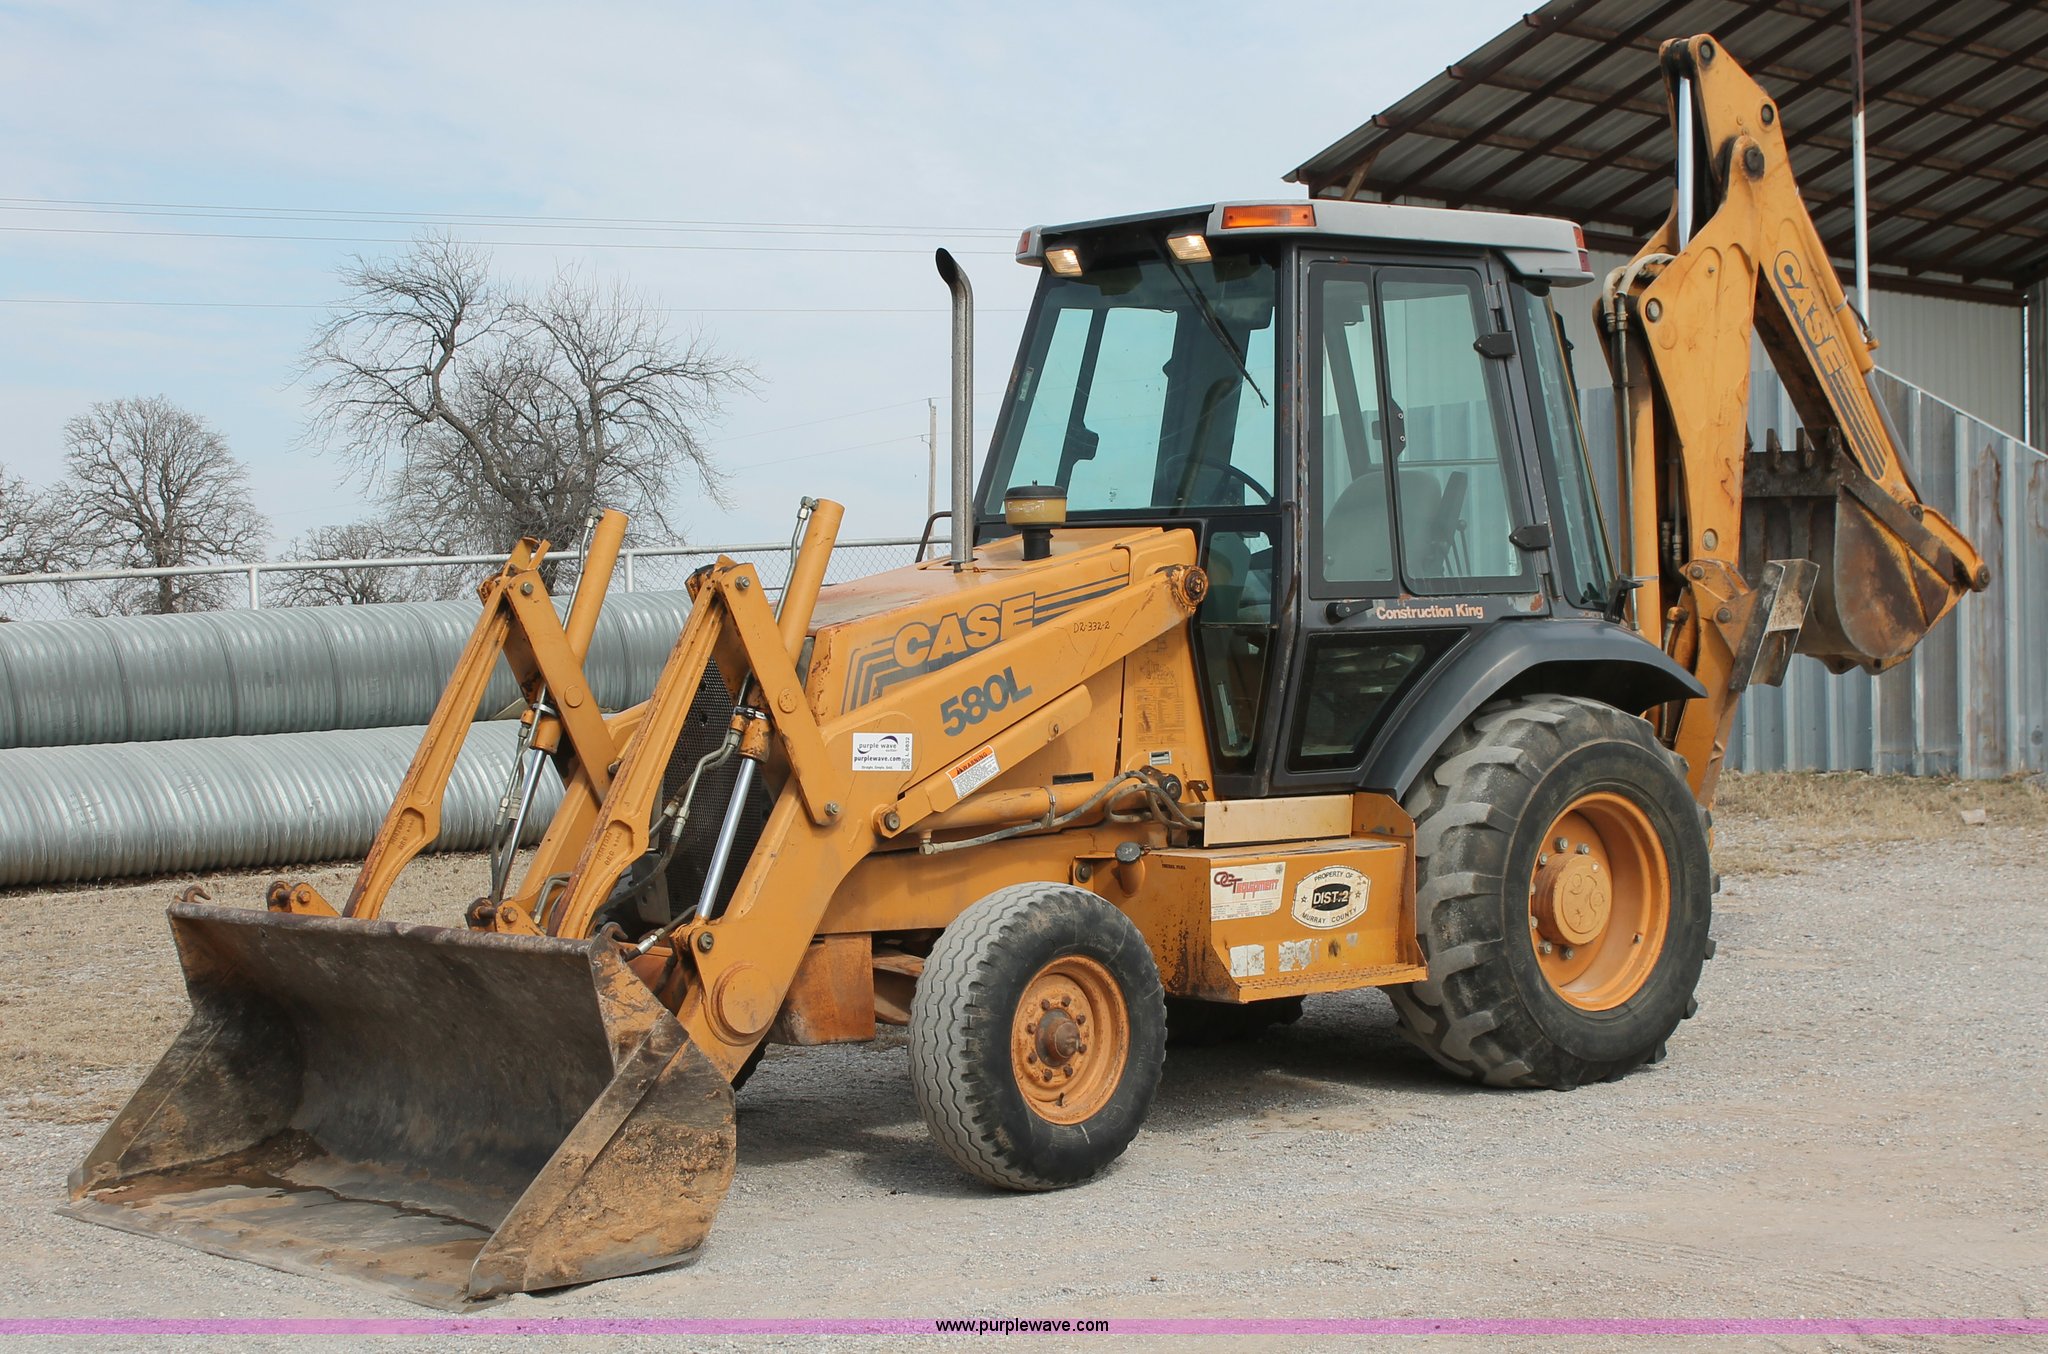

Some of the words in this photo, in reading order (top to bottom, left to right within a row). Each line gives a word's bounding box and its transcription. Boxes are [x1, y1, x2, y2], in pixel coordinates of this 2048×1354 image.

[1773, 250, 1849, 377] CASE
[1376, 605, 1454, 620] Construction
[1455, 604, 1484, 619] King
[893, 592, 1035, 667] CASE
[940, 666, 1032, 737] 580L
[858, 742, 879, 750] purple
[854, 755, 901, 763] purplewave.com
[962, 752, 988, 770] WARNING
[1314, 871, 1343, 882] PROPERTY
[1301, 912, 1326, 924] MURRAY
[1331, 907, 1357, 923] COUNTY
